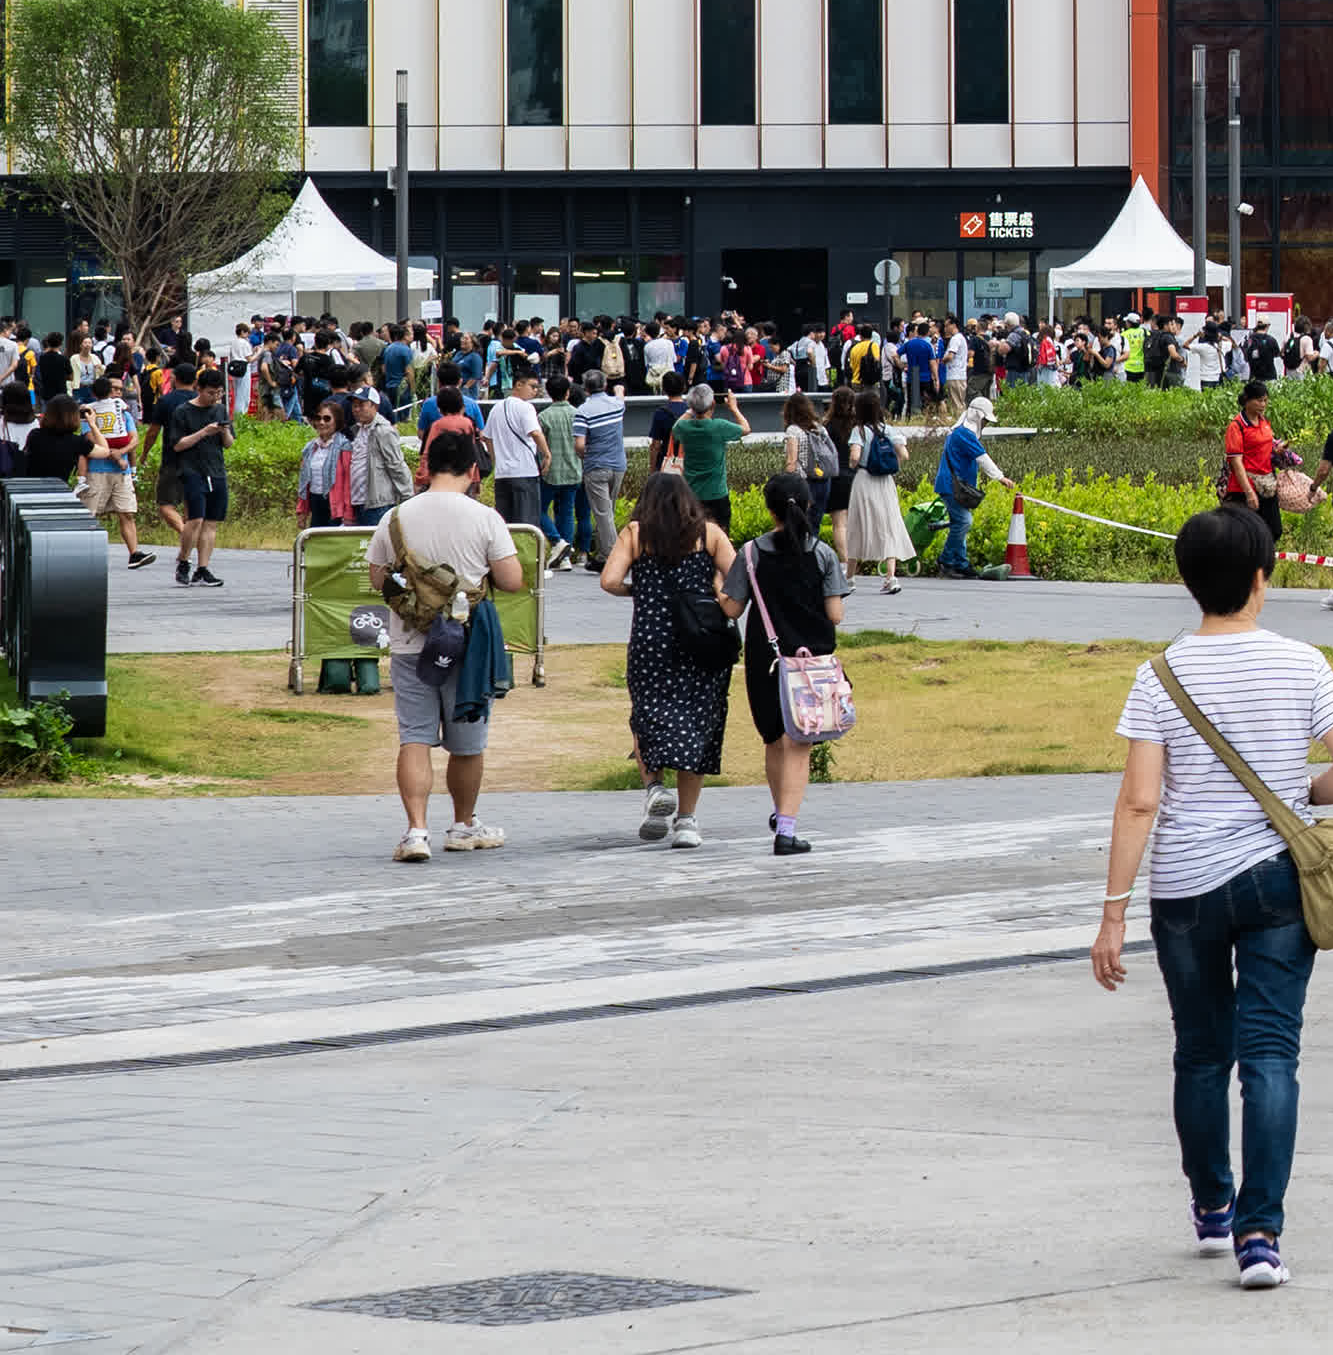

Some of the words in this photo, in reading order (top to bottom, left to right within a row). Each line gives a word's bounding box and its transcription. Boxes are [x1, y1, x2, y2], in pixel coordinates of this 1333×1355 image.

[988, 211, 1034, 227] 售票處
[988, 227, 1034, 239] TICKETS
